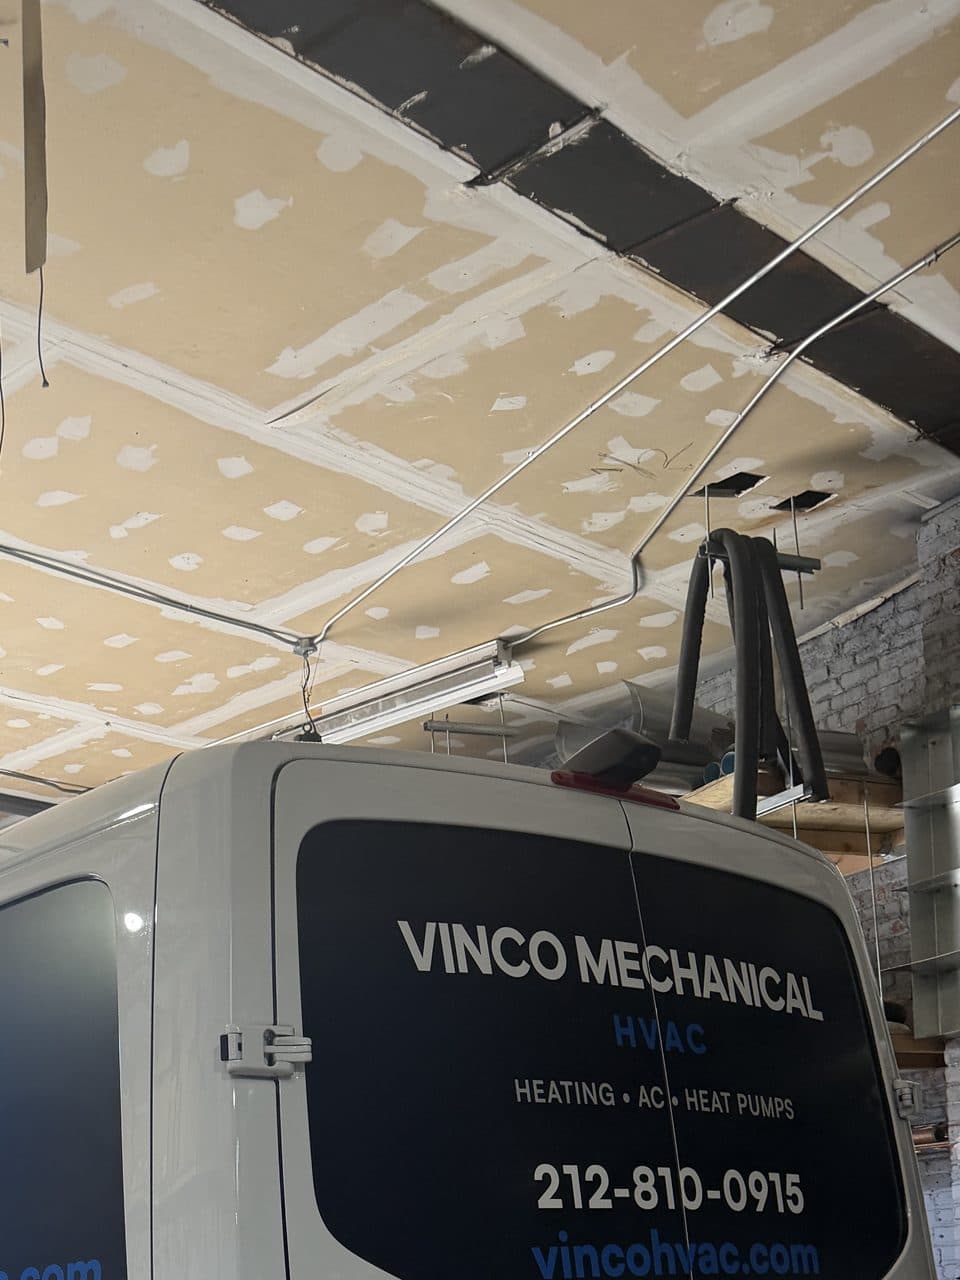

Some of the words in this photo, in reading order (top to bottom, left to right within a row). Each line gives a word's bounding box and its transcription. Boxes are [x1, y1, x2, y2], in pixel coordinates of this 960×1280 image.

[397, 920, 568, 981] VINCO
[575, 935, 824, 1022] MECHANICAL
[613, 1014, 707, 1055] HVAC
[514, 1078, 615, 1108] HEATING
[638, 1085, 665, 1110] AC
[685, 1088, 731, 1114] HEAT
[737, 1092, 796, 1120] PUMPS
[533, 1163, 805, 1214] 212-810-0915
[531, 1229, 821, 1280] vincohvac.com
